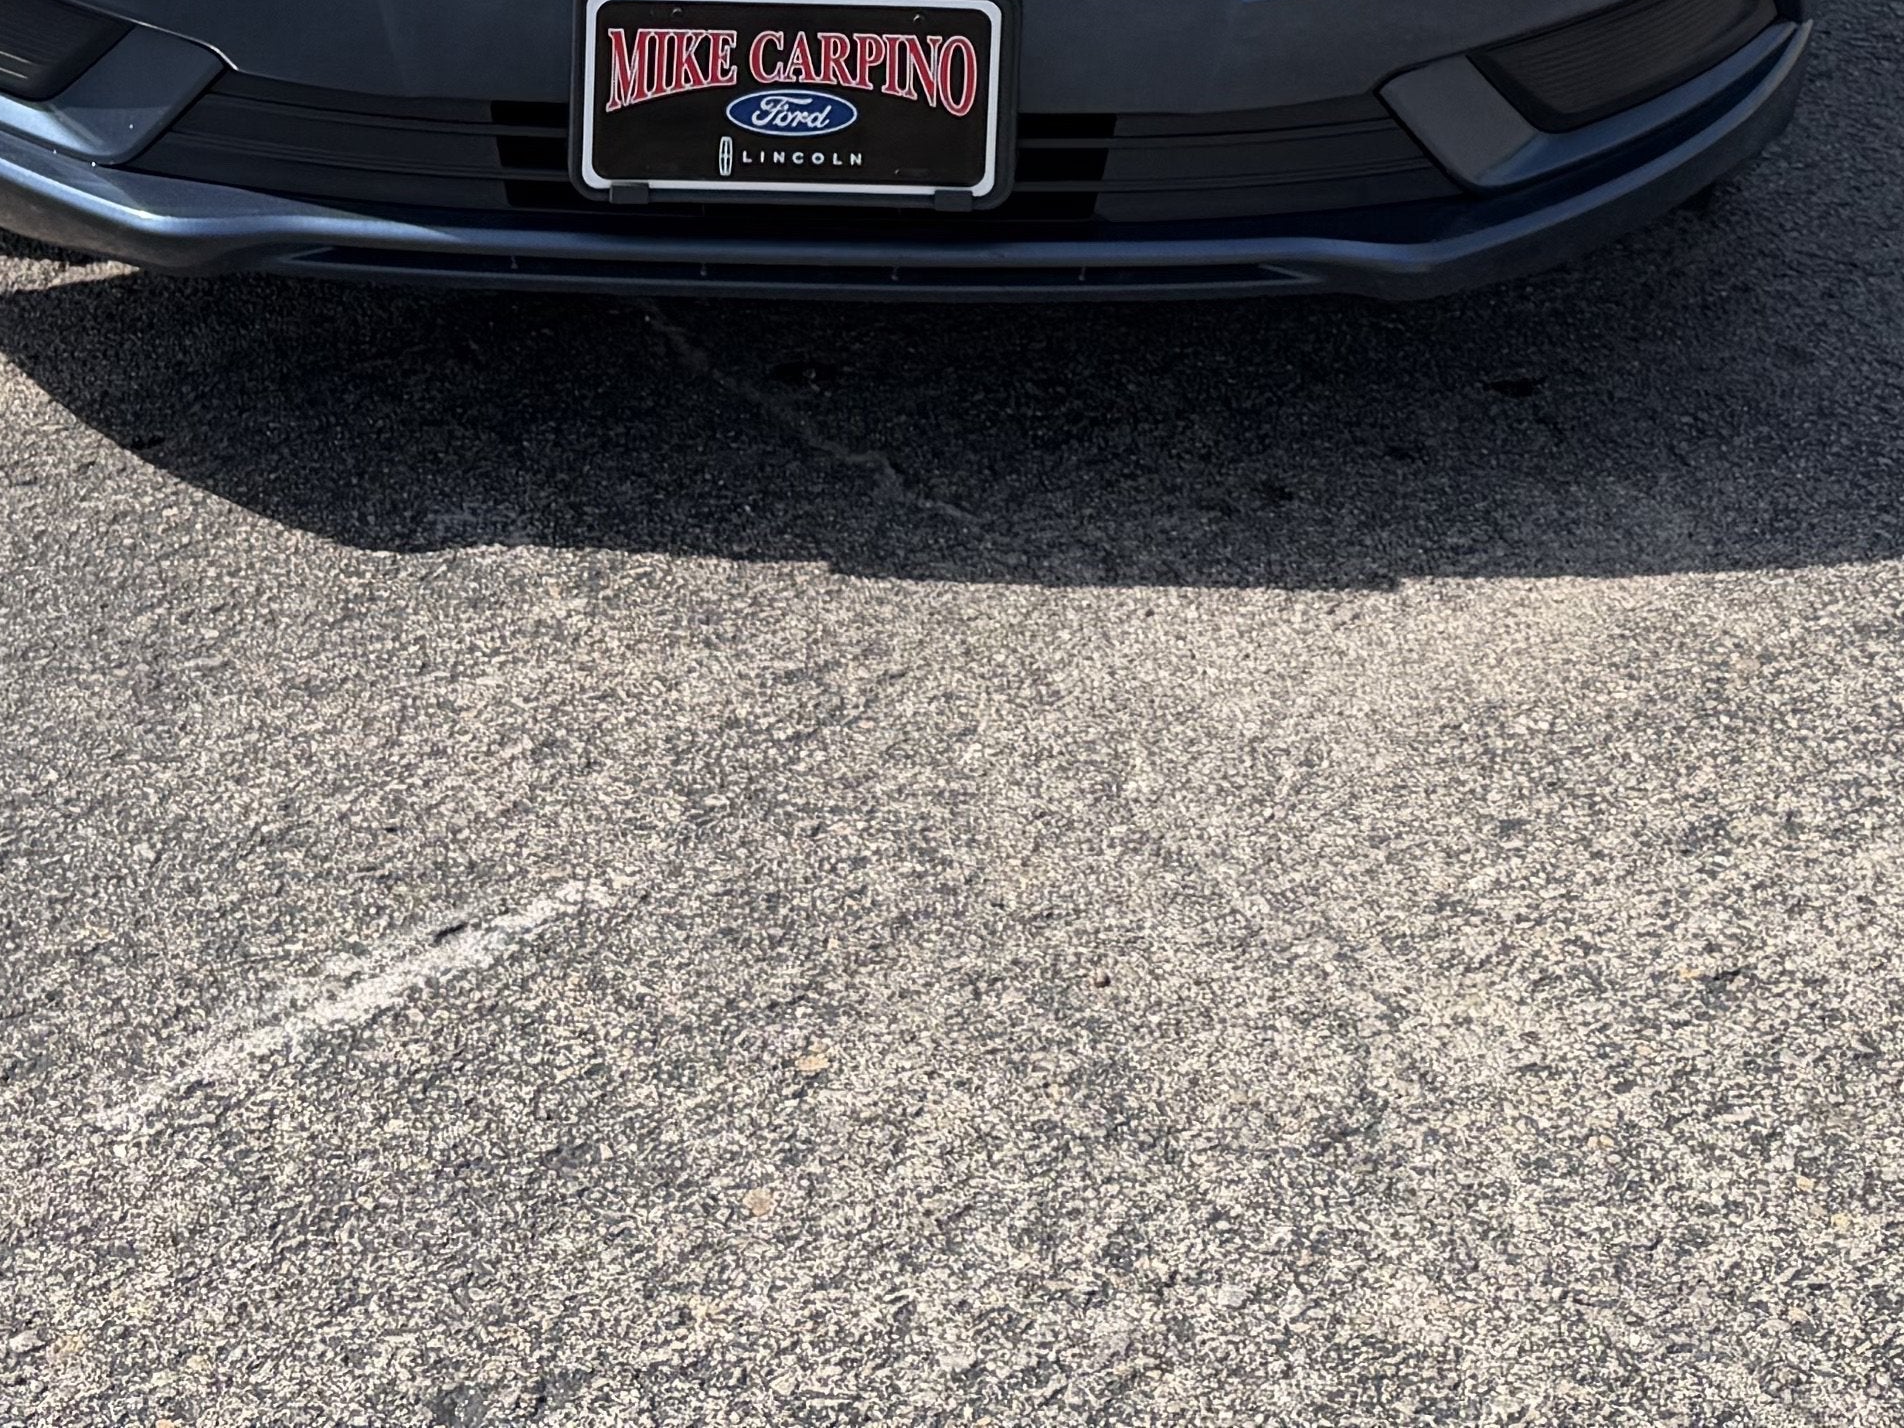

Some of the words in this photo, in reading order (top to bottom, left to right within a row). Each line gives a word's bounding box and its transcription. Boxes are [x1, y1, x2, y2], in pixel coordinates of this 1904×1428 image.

[605, 28, 737, 113] MIKE
[748, 29, 978, 117] CARPINO
[751, 95, 833, 129] Ford
[741, 150, 863, 166] LINCOLN
